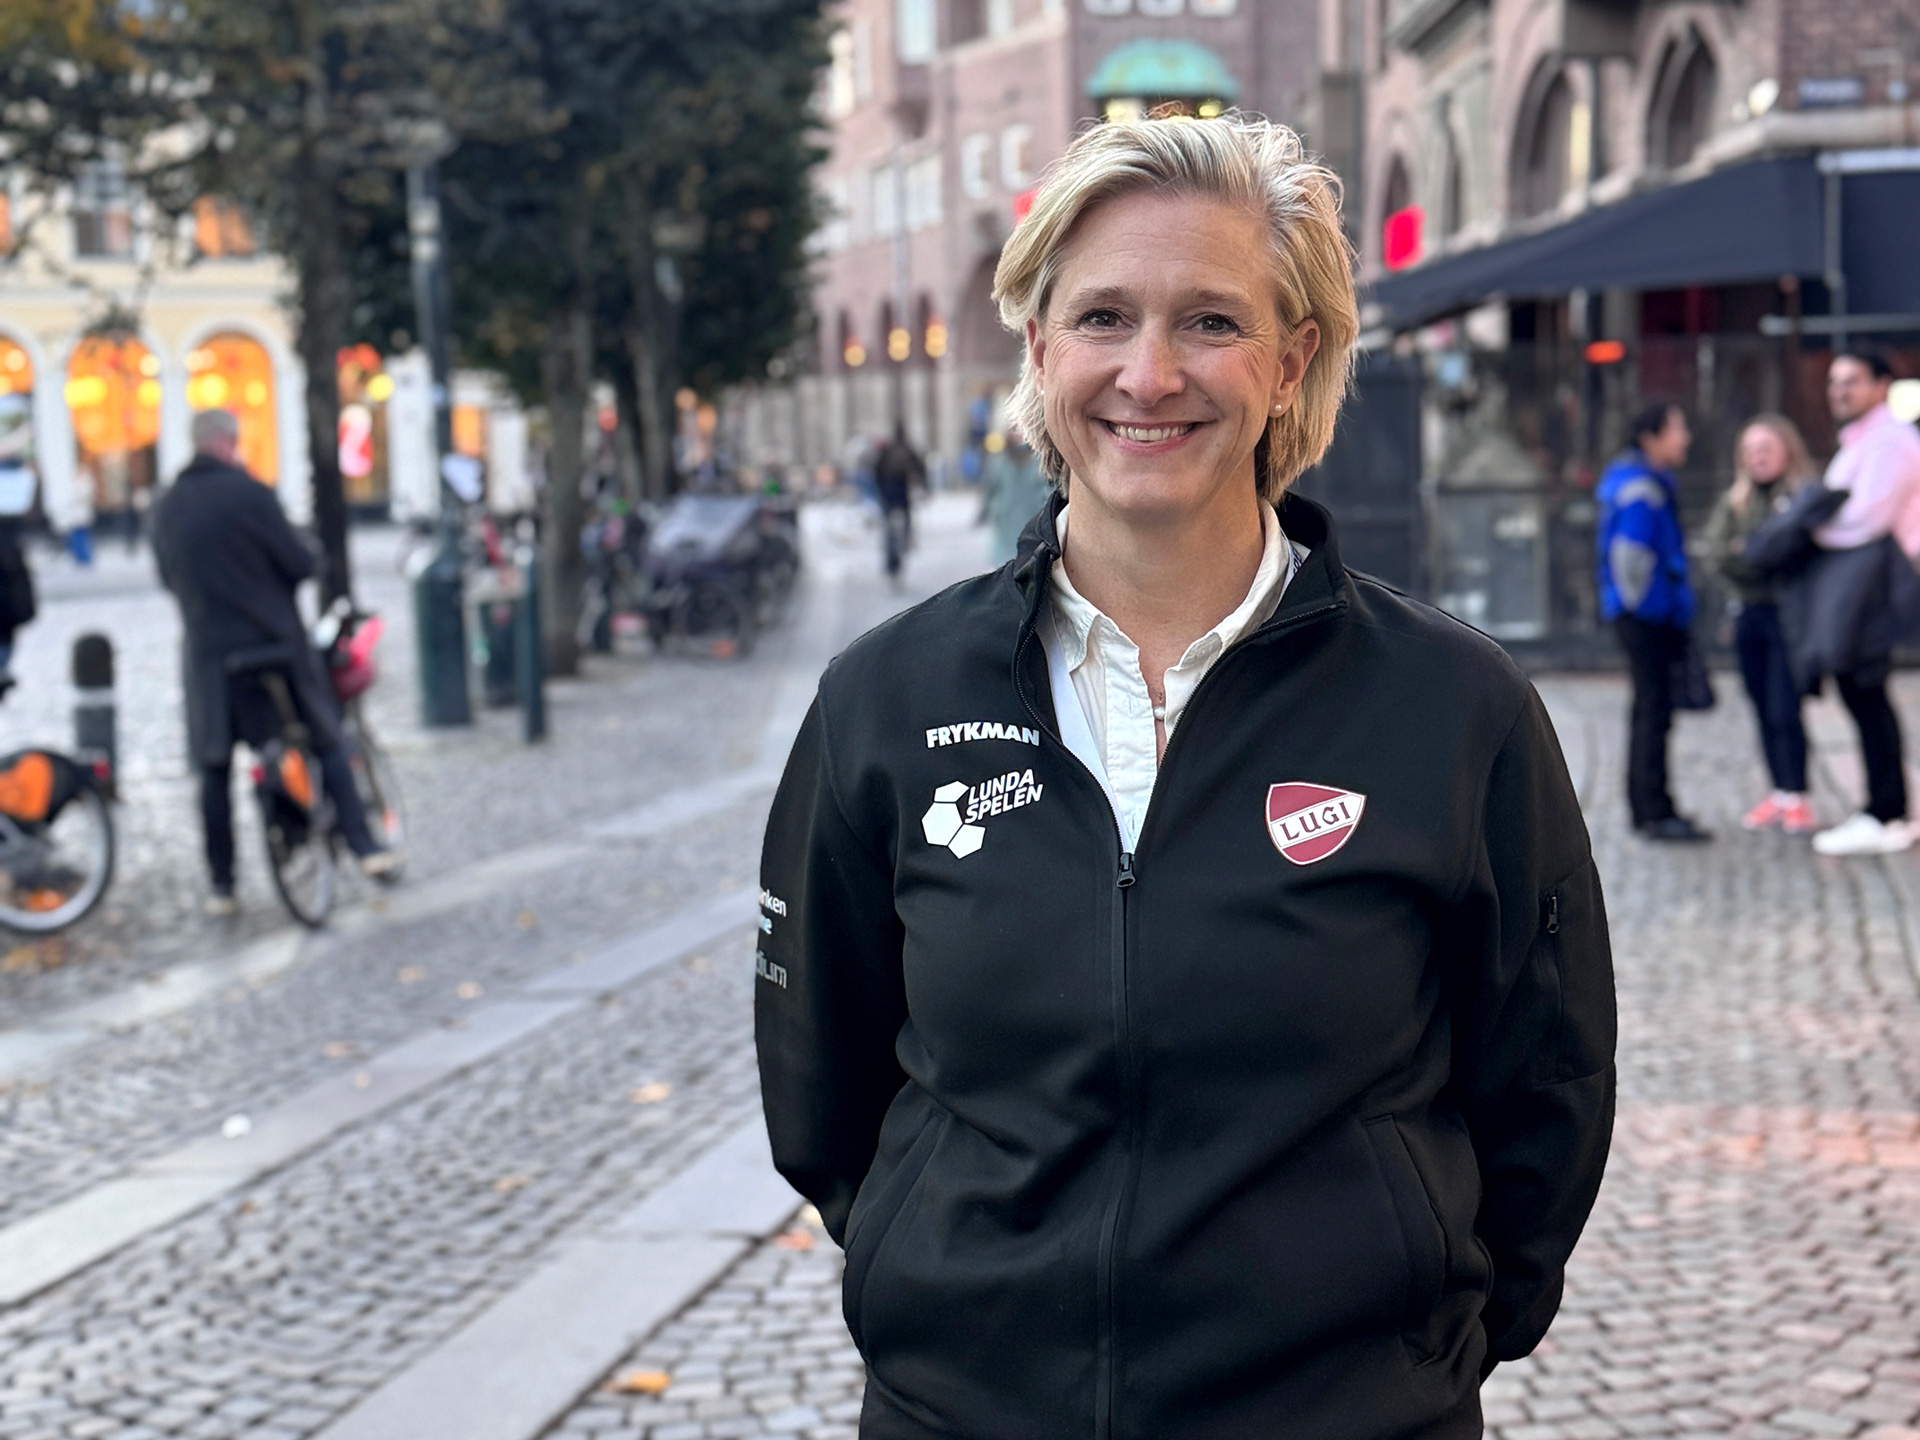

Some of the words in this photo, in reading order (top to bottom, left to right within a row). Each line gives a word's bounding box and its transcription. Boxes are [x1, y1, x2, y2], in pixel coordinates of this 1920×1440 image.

[926, 721, 1040, 749] FRYKMAN
[964, 783, 1043, 824] SPELEN
[968, 768, 1035, 805] LUNDA
[1280, 801, 1351, 841] LUGI
